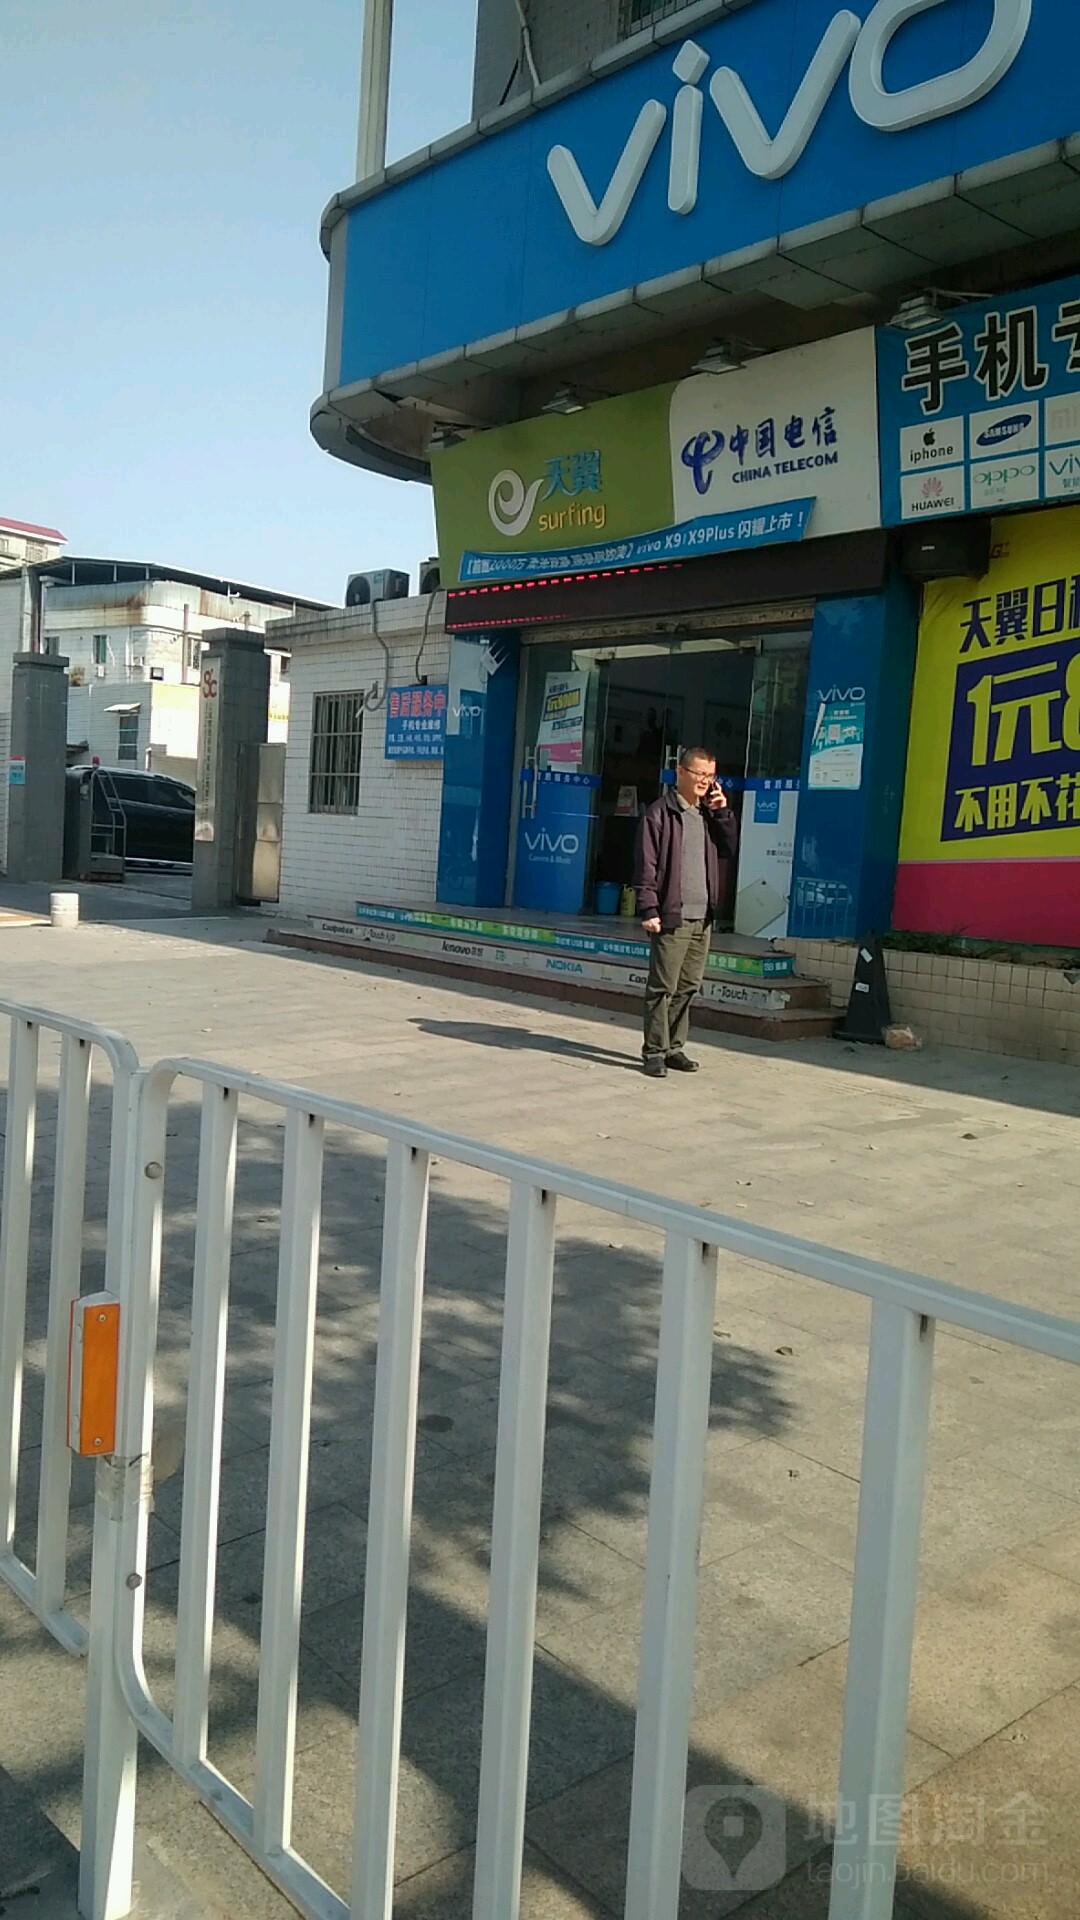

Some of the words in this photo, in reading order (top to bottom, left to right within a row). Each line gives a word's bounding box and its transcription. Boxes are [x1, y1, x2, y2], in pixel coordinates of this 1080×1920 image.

[547, 0, 1033, 246] vivo
[729, 407, 837, 466] 中国电信
[983, 422, 1025, 439] SAMSUNG
[731, 466, 772, 484] CHINA
[773, 451, 838, 475] TELECOM
[910, 446, 954, 464] iphone
[541, 450, 603, 500] 天翼
[538, 502, 606, 532] surfing
[911, 497, 955, 512] HUAWEI
[818, 684, 865, 702] vivo
[524, 827, 579, 854] vivo
[545, 959, 583, 974] NOKIA
